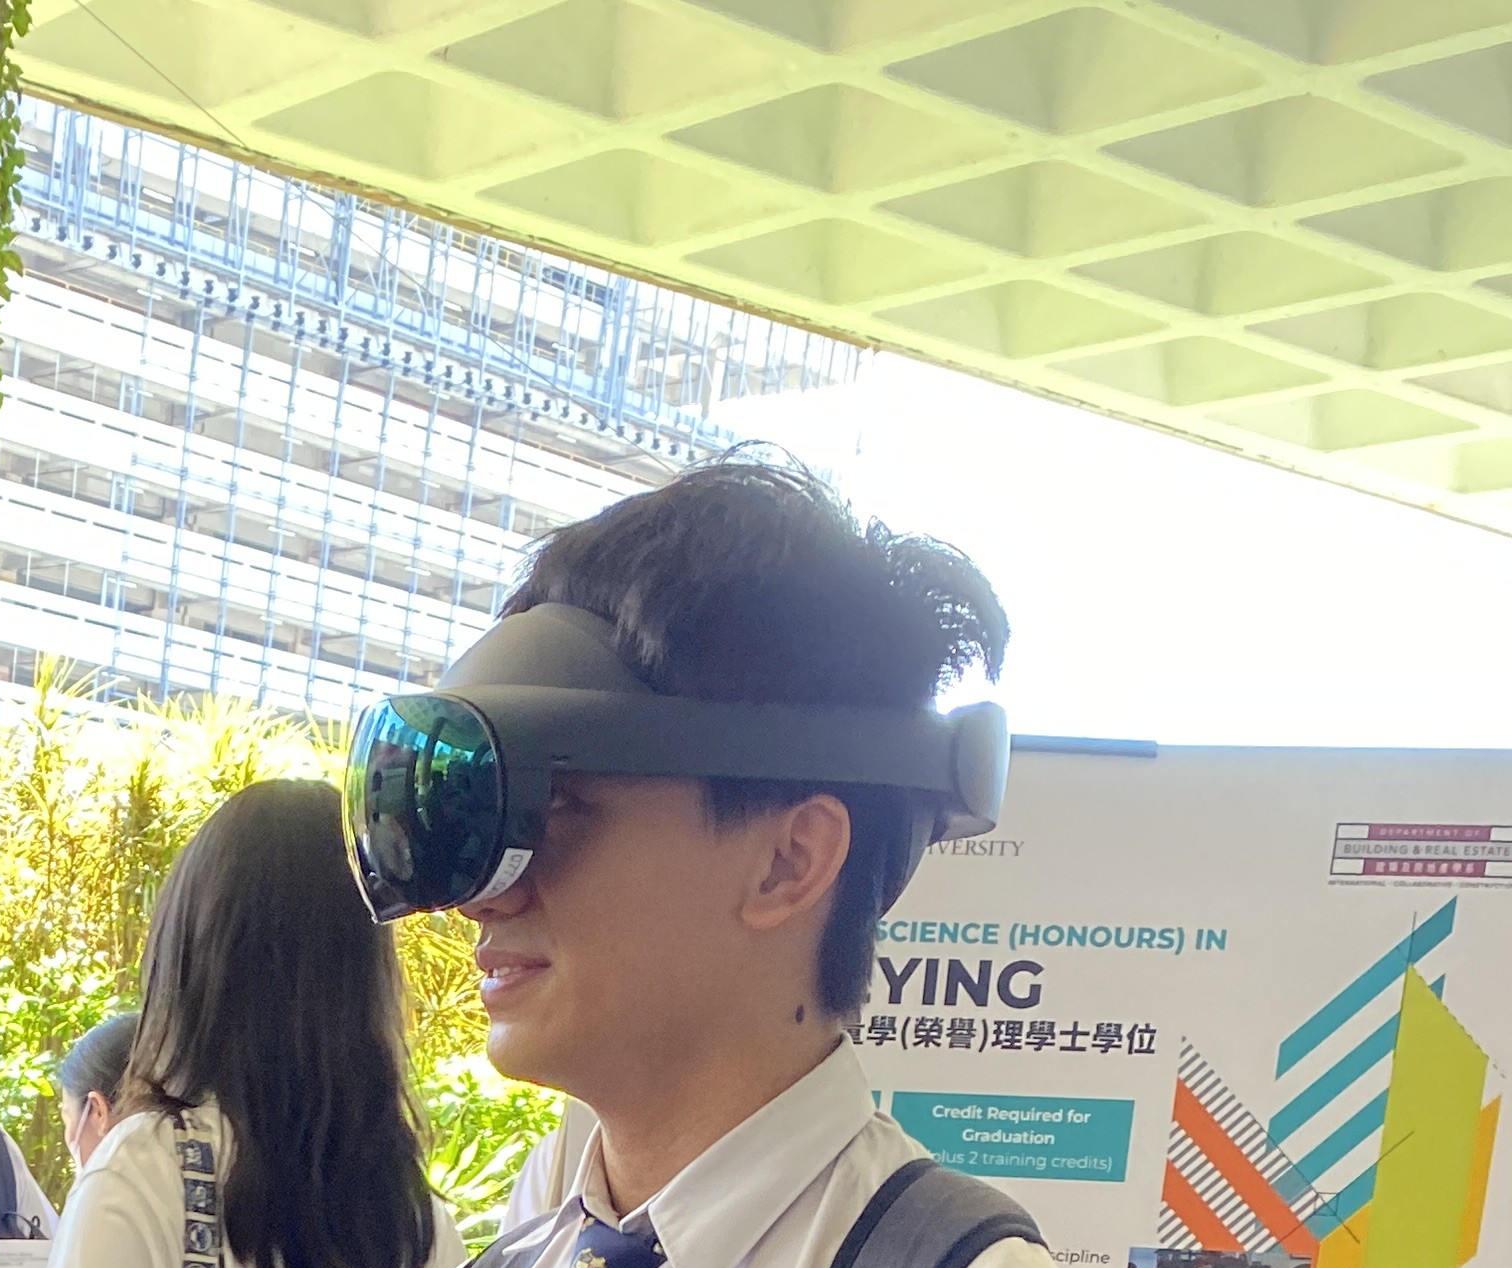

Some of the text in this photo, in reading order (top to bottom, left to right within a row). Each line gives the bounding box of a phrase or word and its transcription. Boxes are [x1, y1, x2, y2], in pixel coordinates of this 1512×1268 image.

[1343, 843, 1511, 857] BUILDING & REAL ESTATE
[1008, 923, 1186, 956] (HONOURS)
[1195, 929, 1228, 951] IN
[865, 957, 1045, 1009] YING
[932, 1104, 1092, 1125] Credit Required for
[961, 1128, 1056, 1146] Graduation
[967, 1152, 979, 1165] 2
[982, 1153, 1047, 1171] training
[1050, 1156, 1113, 1173] credits)
